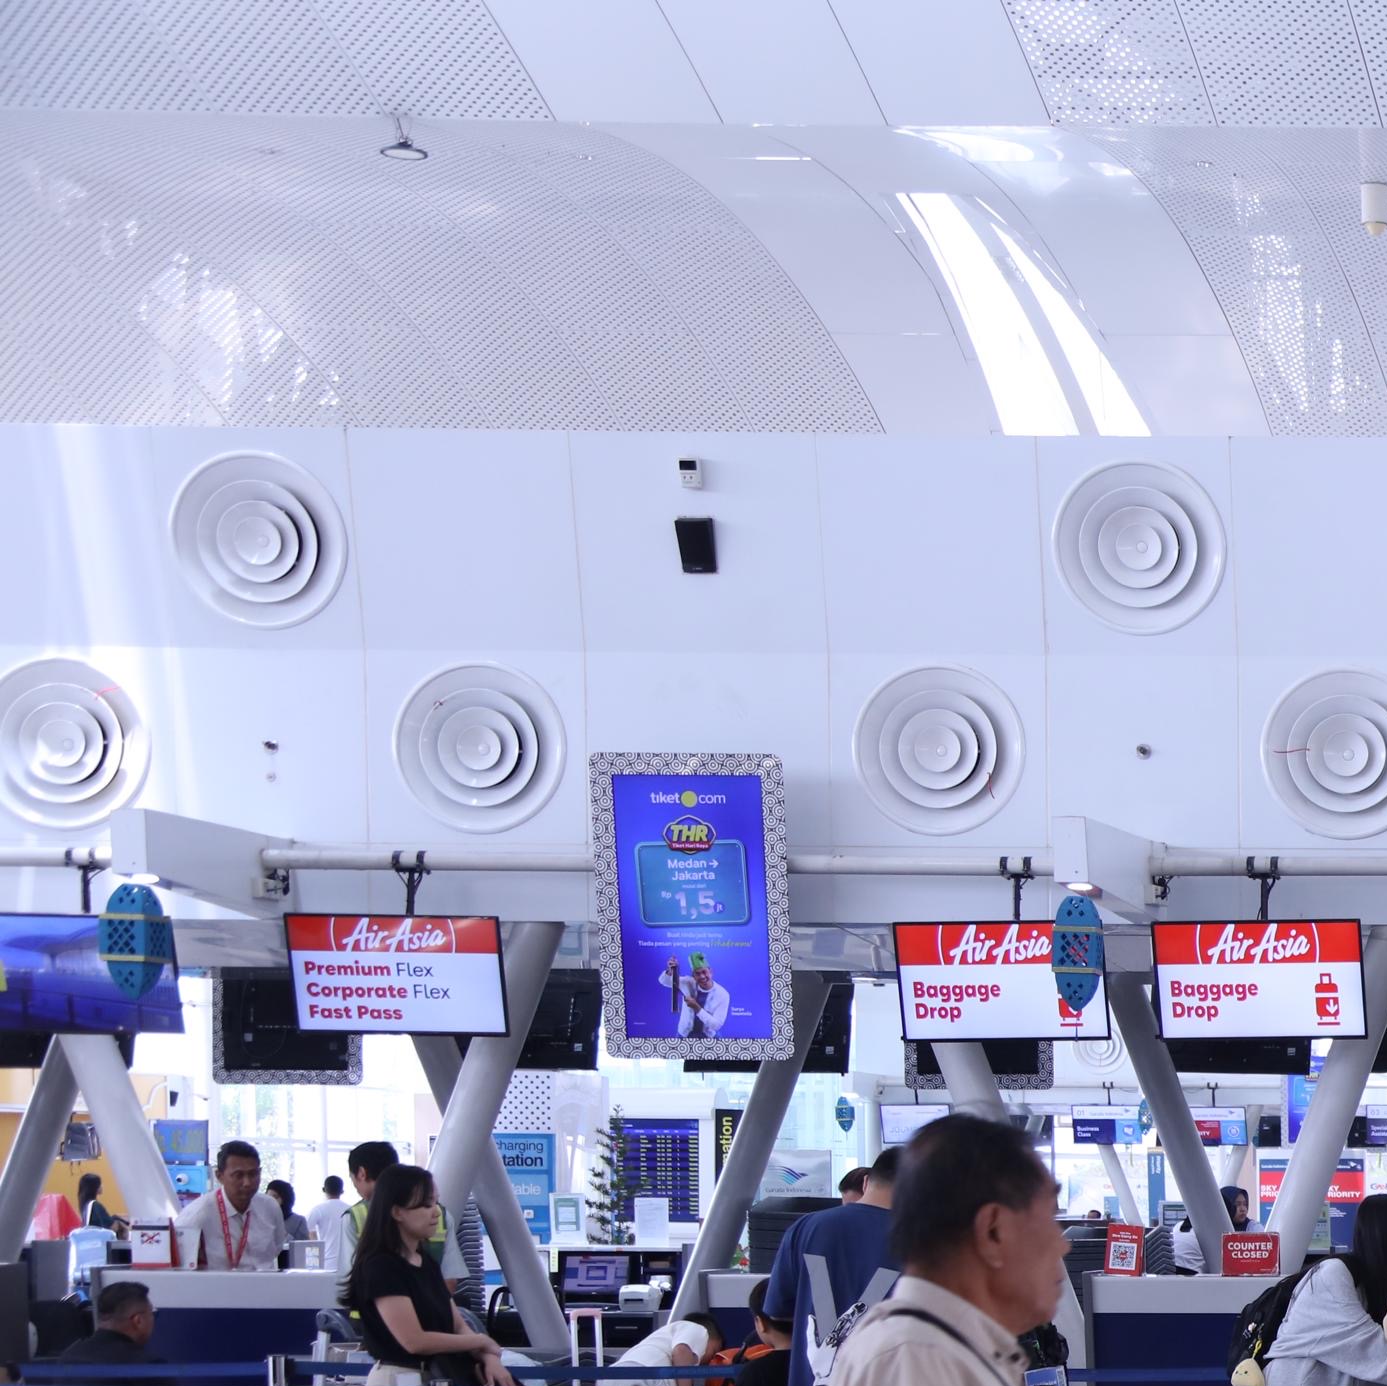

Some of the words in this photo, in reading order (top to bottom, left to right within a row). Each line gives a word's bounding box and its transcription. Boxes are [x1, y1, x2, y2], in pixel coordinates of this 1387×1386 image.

[671, 825, 709, 842] THR
[667, 859, 707, 869] Medan
[672, 871, 715, 881] Jakarta
[661, 891, 672, 900] Rp
[304, 960, 391, 976] Premium
[396, 962, 433, 977] Flex
[306, 982, 408, 1001] Corporate
[413, 984, 450, 999] Flex
[913, 981, 1001, 1003] Baggage
[1170, 980, 1259, 1002] Baggage
[309, 1005, 352, 1019] Fast
[357, 1005, 403, 1020] Pass
[915, 1003, 962, 1022] Drop
[1172, 1001, 1219, 1021] Drop
[503, 1154, 543, 1167] tation
[1228, 1242, 1273, 1250] COUNTER
[1231, 1251, 1269, 1259] CLOSED
